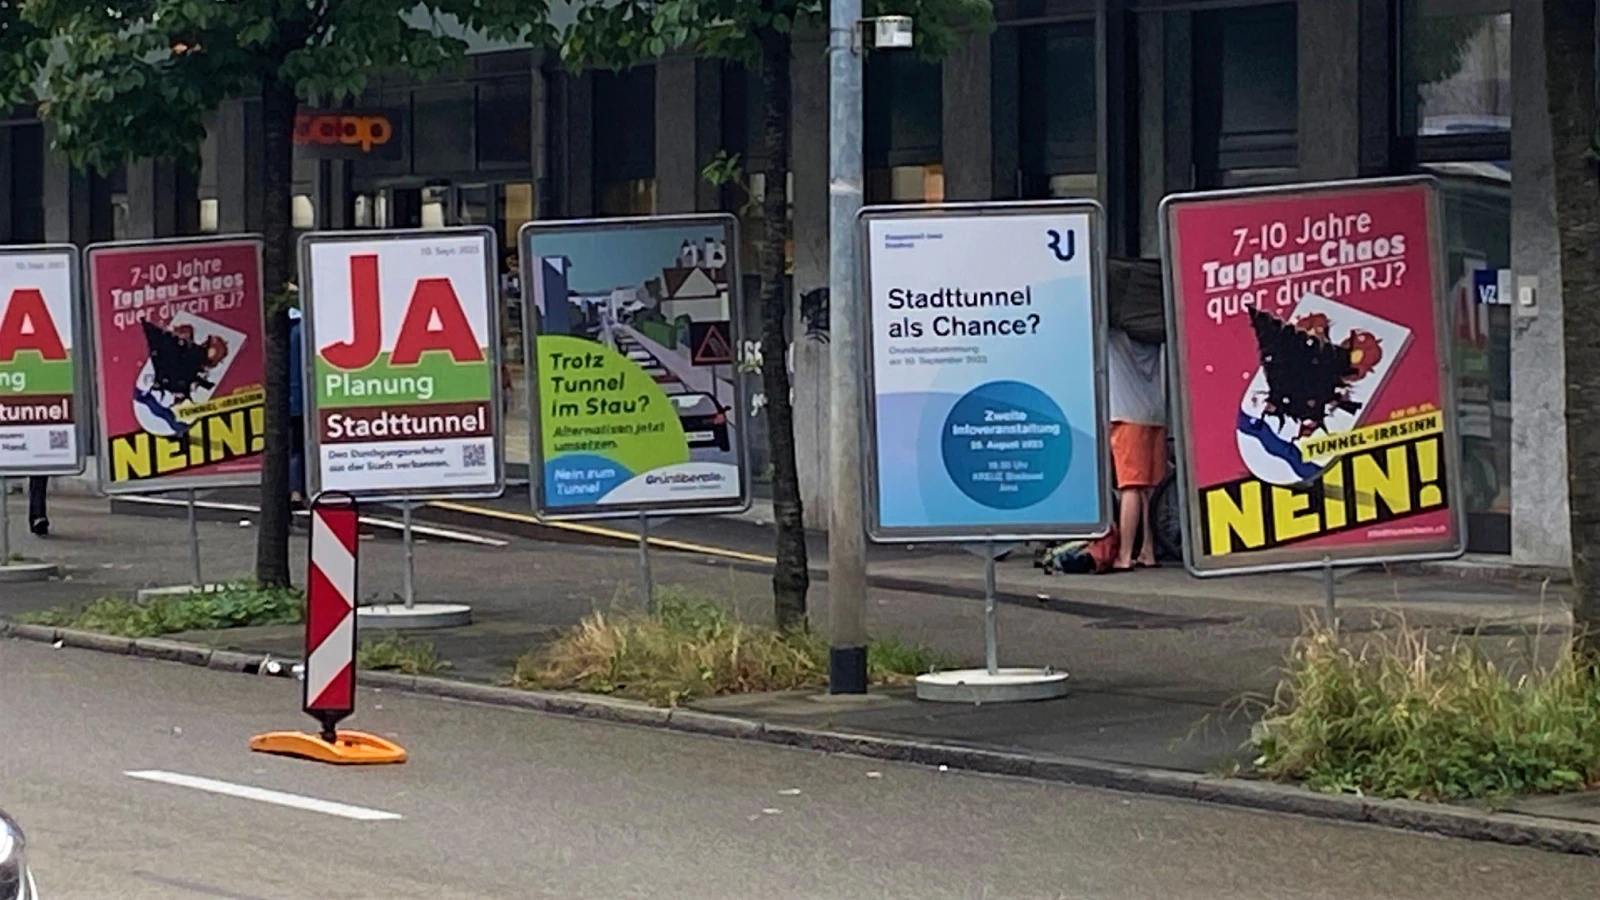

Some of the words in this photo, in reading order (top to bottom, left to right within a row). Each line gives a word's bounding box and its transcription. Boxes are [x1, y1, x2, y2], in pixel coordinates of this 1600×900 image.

[1232, 221, 1289, 257] 7-10
[1295, 211, 1372, 246] Jahre
[130, 263, 167, 286] 7-10
[171, 258, 222, 279] Jahre
[1202, 235, 1406, 292] Tagbau-Chaos
[110, 272, 244, 310] Tagbau-Chaos
[887, 285, 1032, 310] Stadttunnel
[1206, 288, 1267, 325] quer
[1276, 270, 1351, 308] durch
[1359, 261, 1407, 292] RJ?
[113, 306, 155, 330] quer
[159, 298, 209, 320] durch
[214, 291, 245, 311] RJ?
[319, 254, 487, 371] JA
[0, 288, 69, 361] A
[888, 316, 923, 338] als
[932, 312, 1041, 337] Chance?
[551, 352, 604, 371] Trotz
[0, 371, 26, 391] ng
[325, 373, 434, 400] Planung
[551, 373, 625, 394] Tunnel
[0, 398, 69, 420] tunnel
[551, 400, 579, 418] im
[586, 395, 651, 415] Stau?
[984, 409, 1028, 421] Zweite
[326, 407, 486, 438] Stadttunnel
[952, 423, 1060, 436] Infoveranstaltung
[112, 406, 265, 483] NEIN!
[1306, 415, 1437, 458] TUNNEL-IRRSINN
[554, 468, 584, 480] Nein
[587, 468, 616, 480] zum
[556, 481, 600, 495] Tunnel
[1205, 437, 1443, 556] NEIN!
